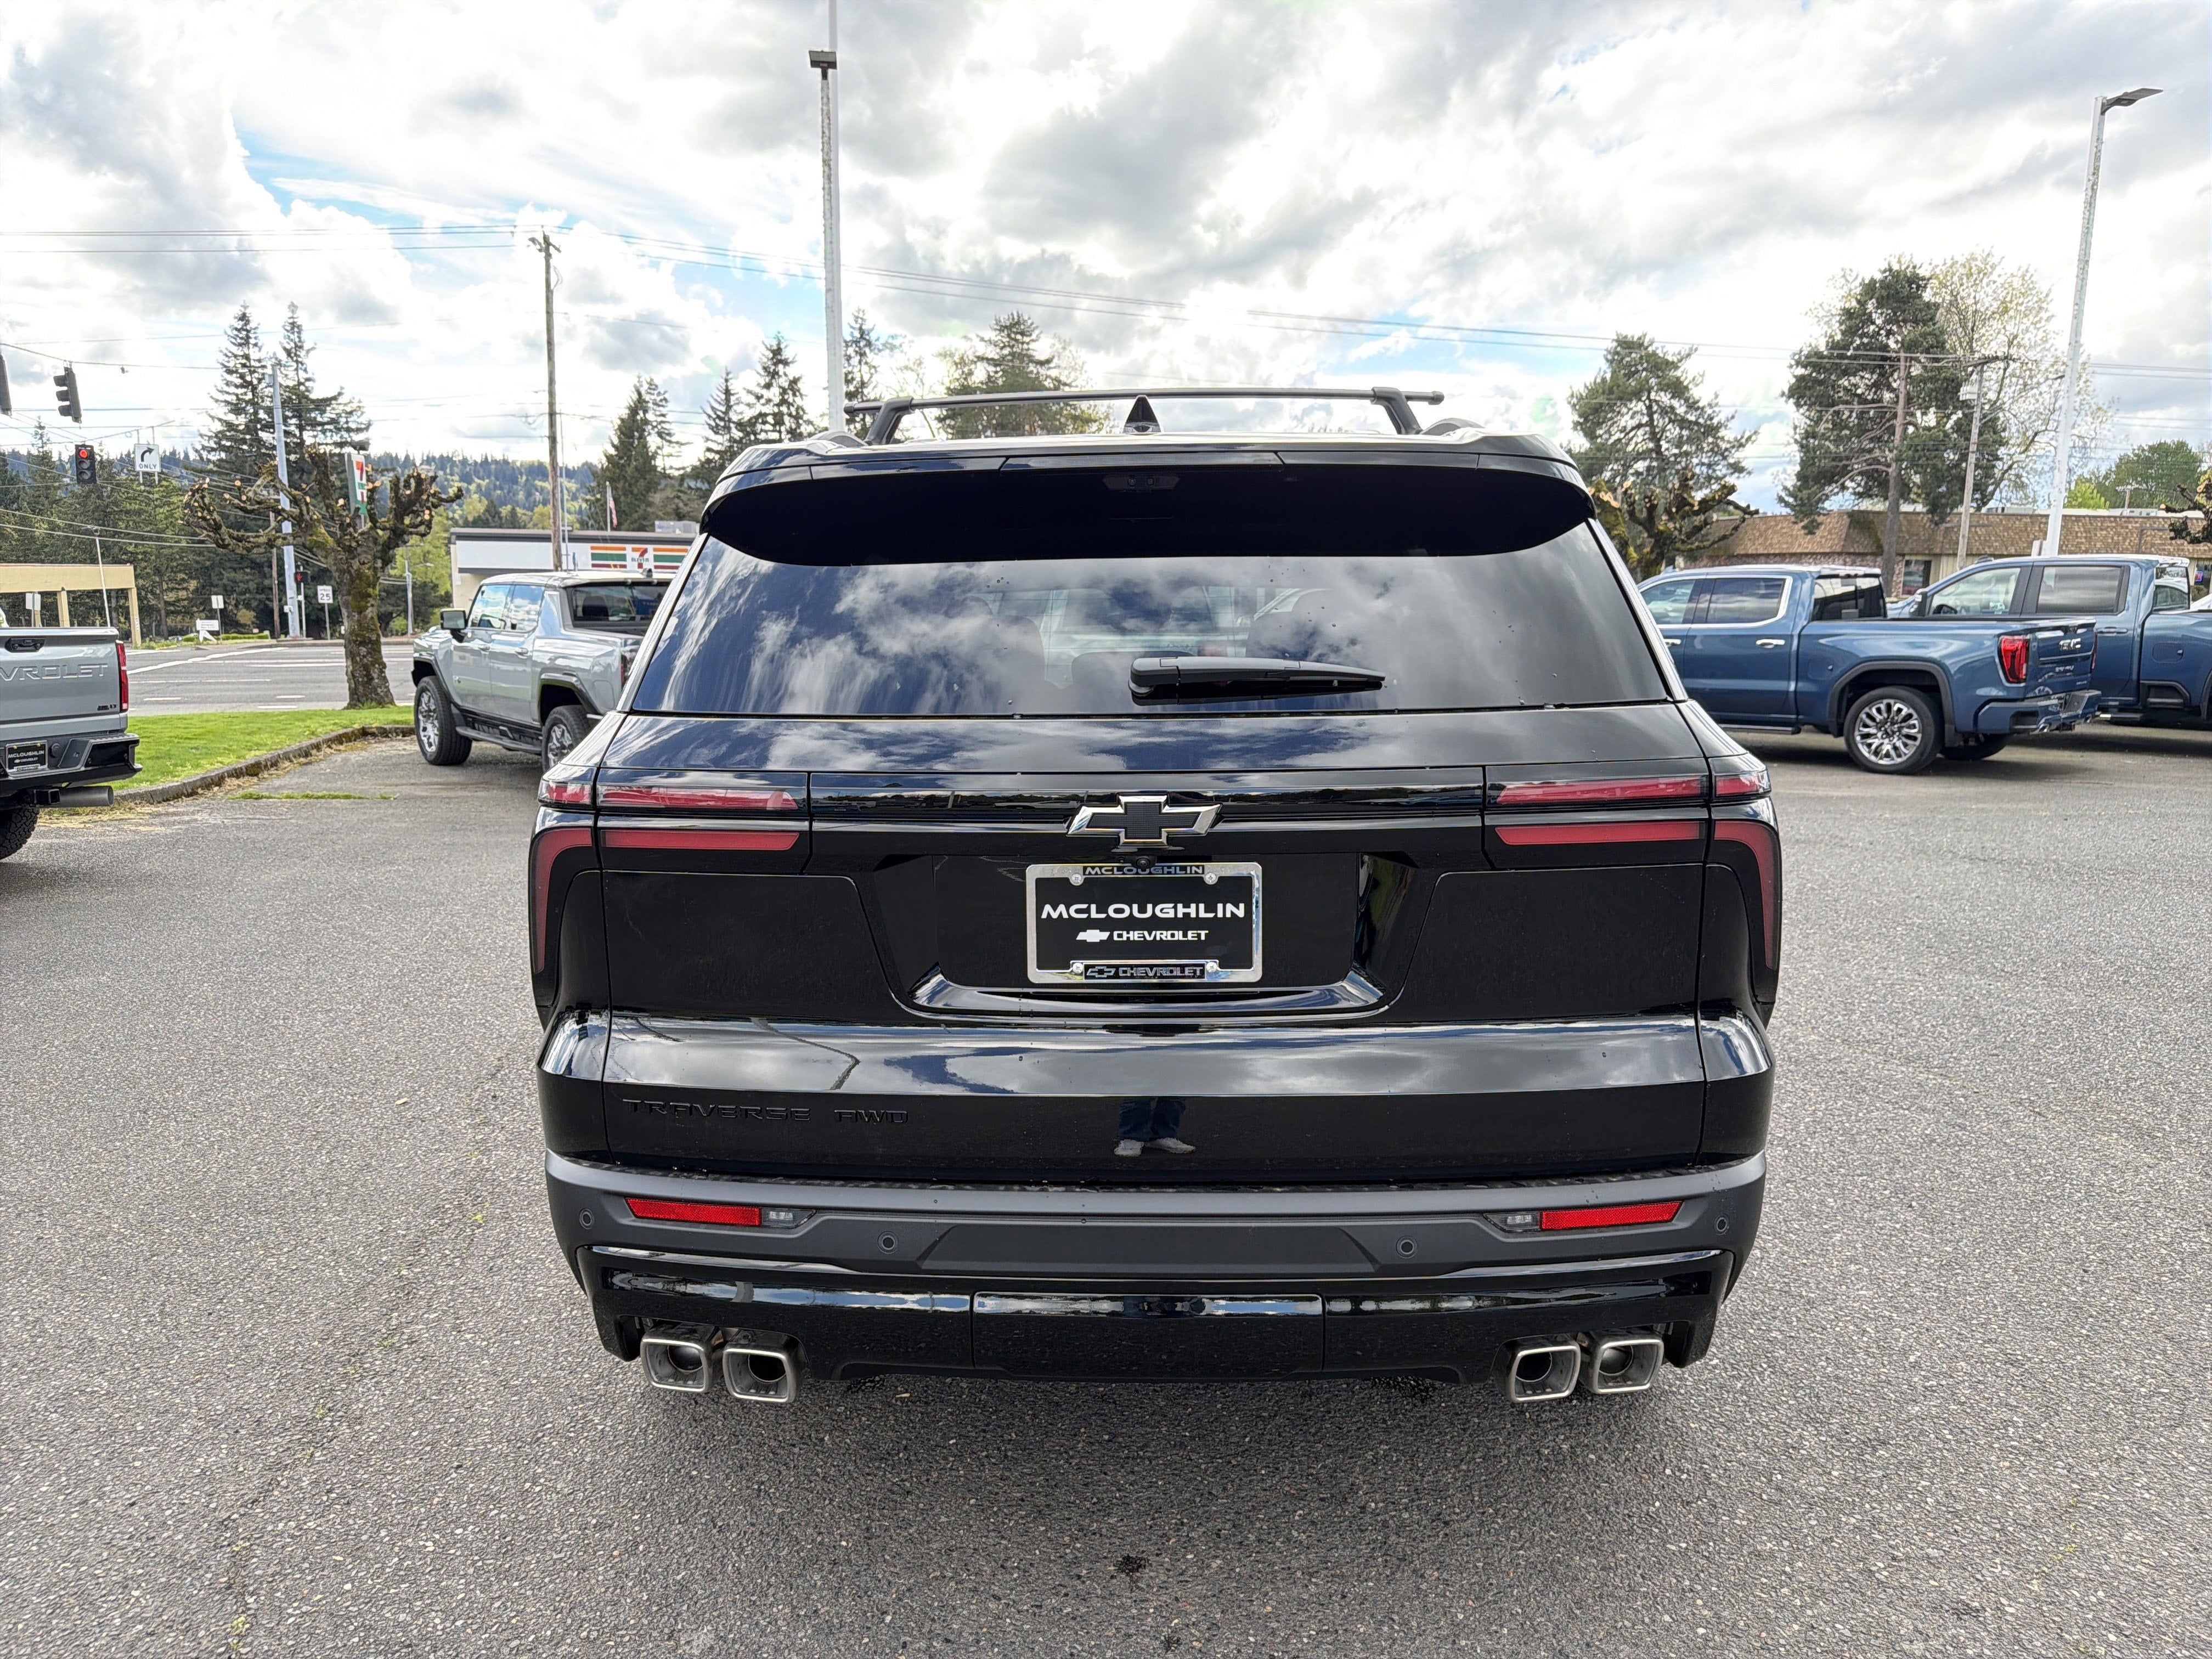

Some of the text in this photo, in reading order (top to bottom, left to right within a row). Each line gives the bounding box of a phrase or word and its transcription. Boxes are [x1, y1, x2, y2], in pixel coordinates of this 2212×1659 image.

[8, 750, 44, 758] MCLOUGHLIN
[1041, 903, 1245, 919] MCLOUGHLIN
[1113, 930, 1209, 941] CHEVROLET
[1119, 967, 1204, 977] CHEVROLET
[623, 1099, 909, 1124] TRAVERSE AWD
